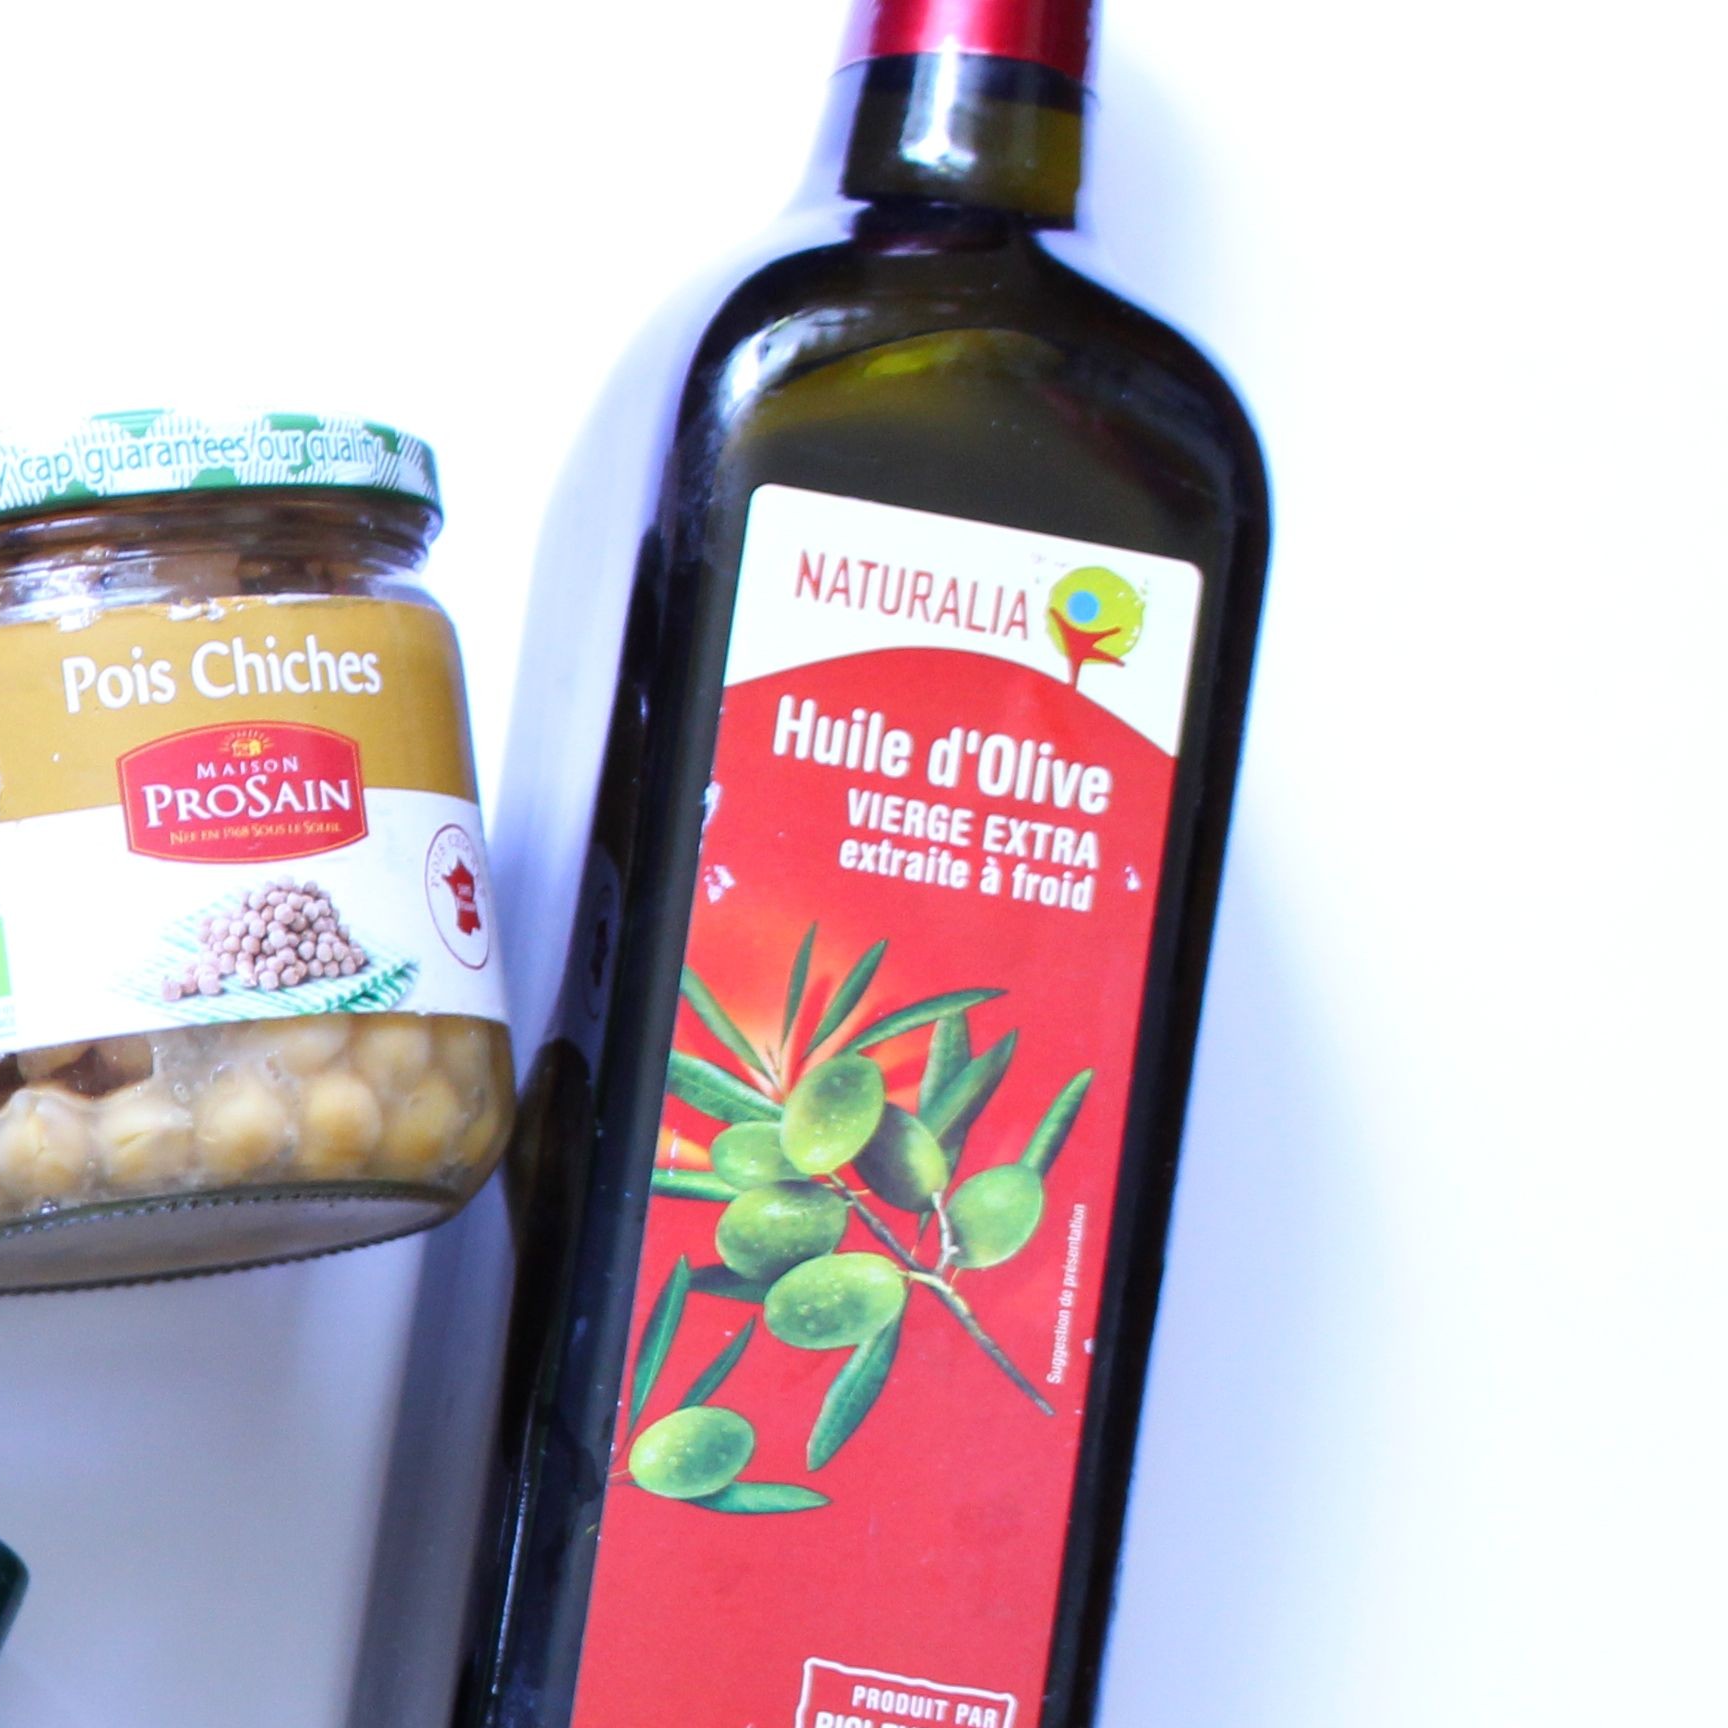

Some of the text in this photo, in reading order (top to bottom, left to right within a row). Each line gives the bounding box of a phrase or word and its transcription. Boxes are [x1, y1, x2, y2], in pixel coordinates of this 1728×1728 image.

[20, 452, 74, 493] cap
[89, 434, 246, 484] guarantees
[258, 436, 301, 461] our
[309, 431, 383, 475] quality
[795, 548, 1029, 641] NATURALIA
[61, 634, 381, 713] Pois Chiches
[197, 756, 299, 780] MAISON
[772, 694, 1113, 815] Huile d'Olive
[847, 787, 1099, 871] VIERGE EXTRA
[839, 837, 1096, 913] extraite à froid
[1046, 1203, 1087, 1385] Suggestion de présentation
[851, 1684, 950, 1722] PRODUIT
